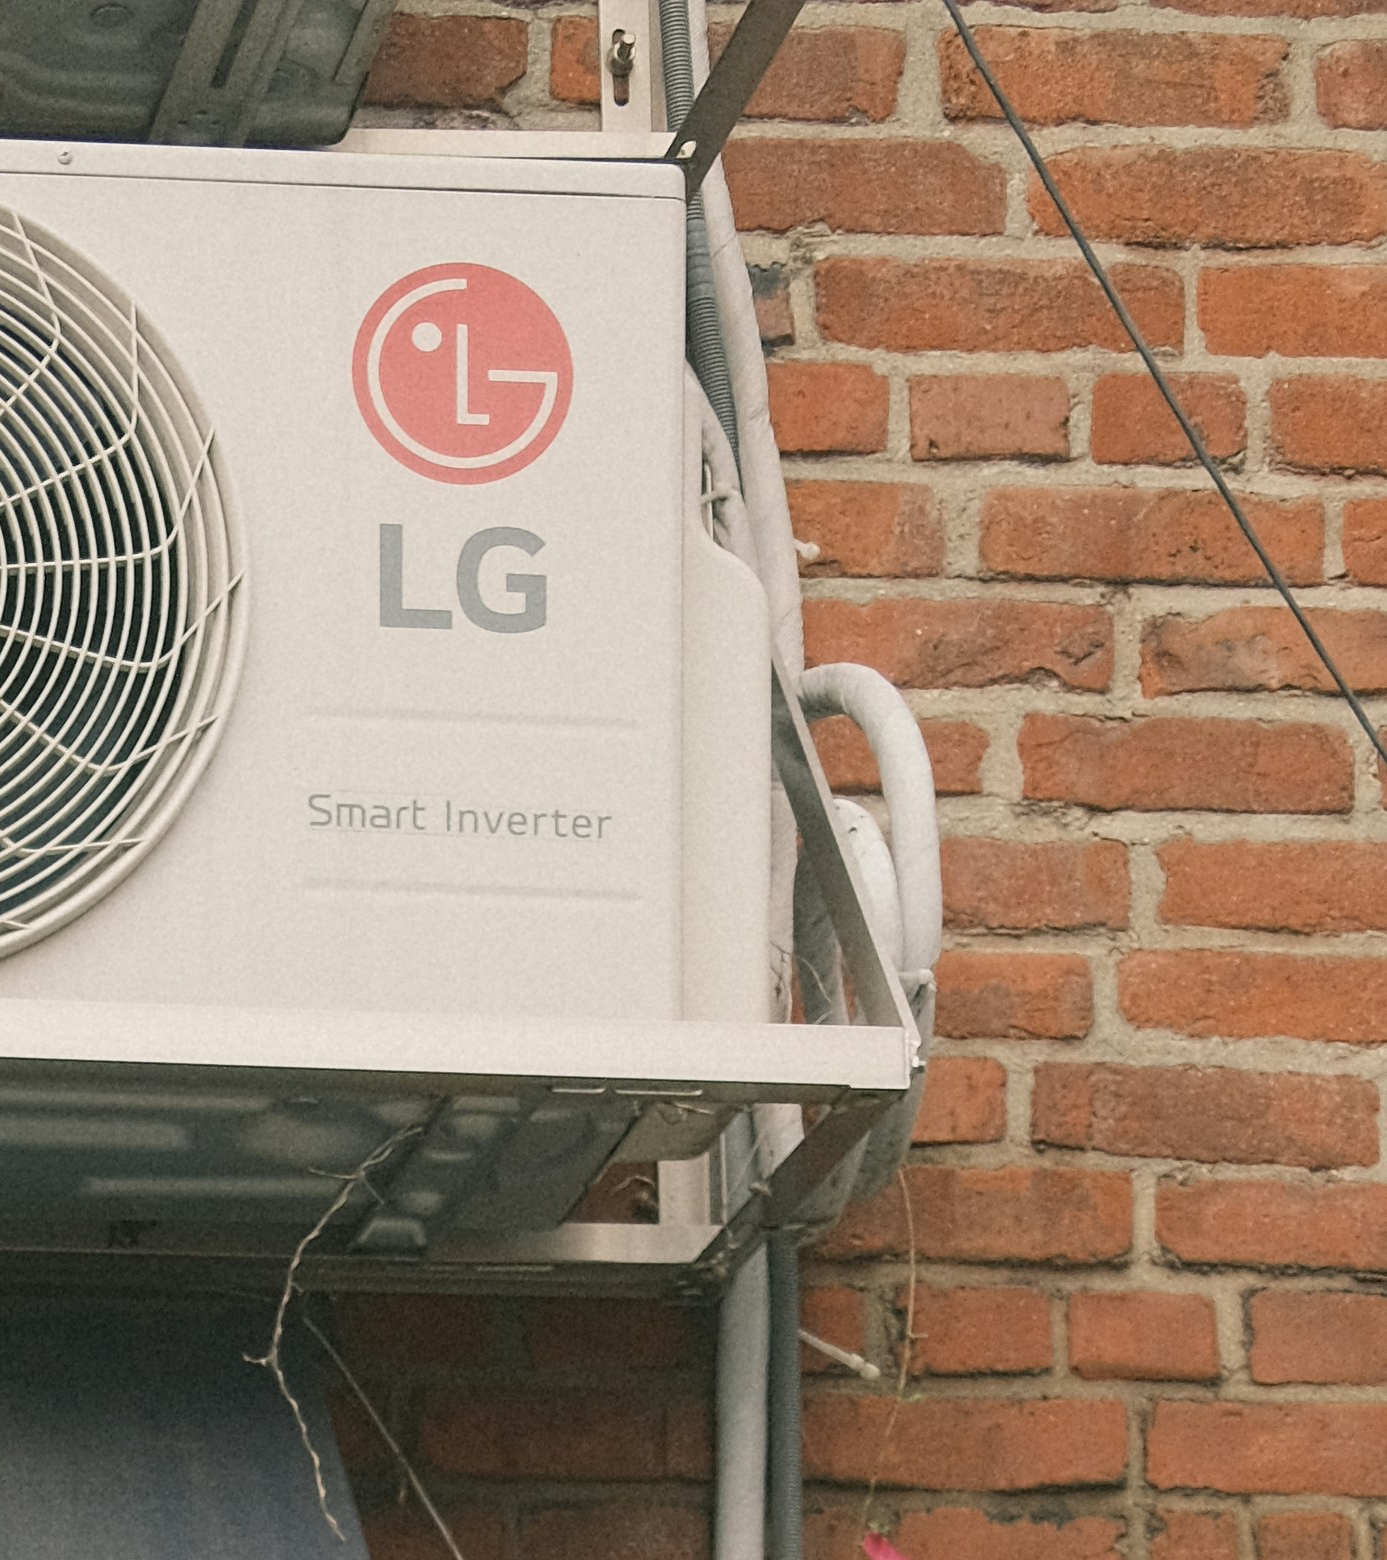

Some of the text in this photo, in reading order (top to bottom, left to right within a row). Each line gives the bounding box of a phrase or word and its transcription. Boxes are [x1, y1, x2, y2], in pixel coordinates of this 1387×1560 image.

[379, 523, 548, 634] LG
[307, 793, 613, 840] Smart Inverter
